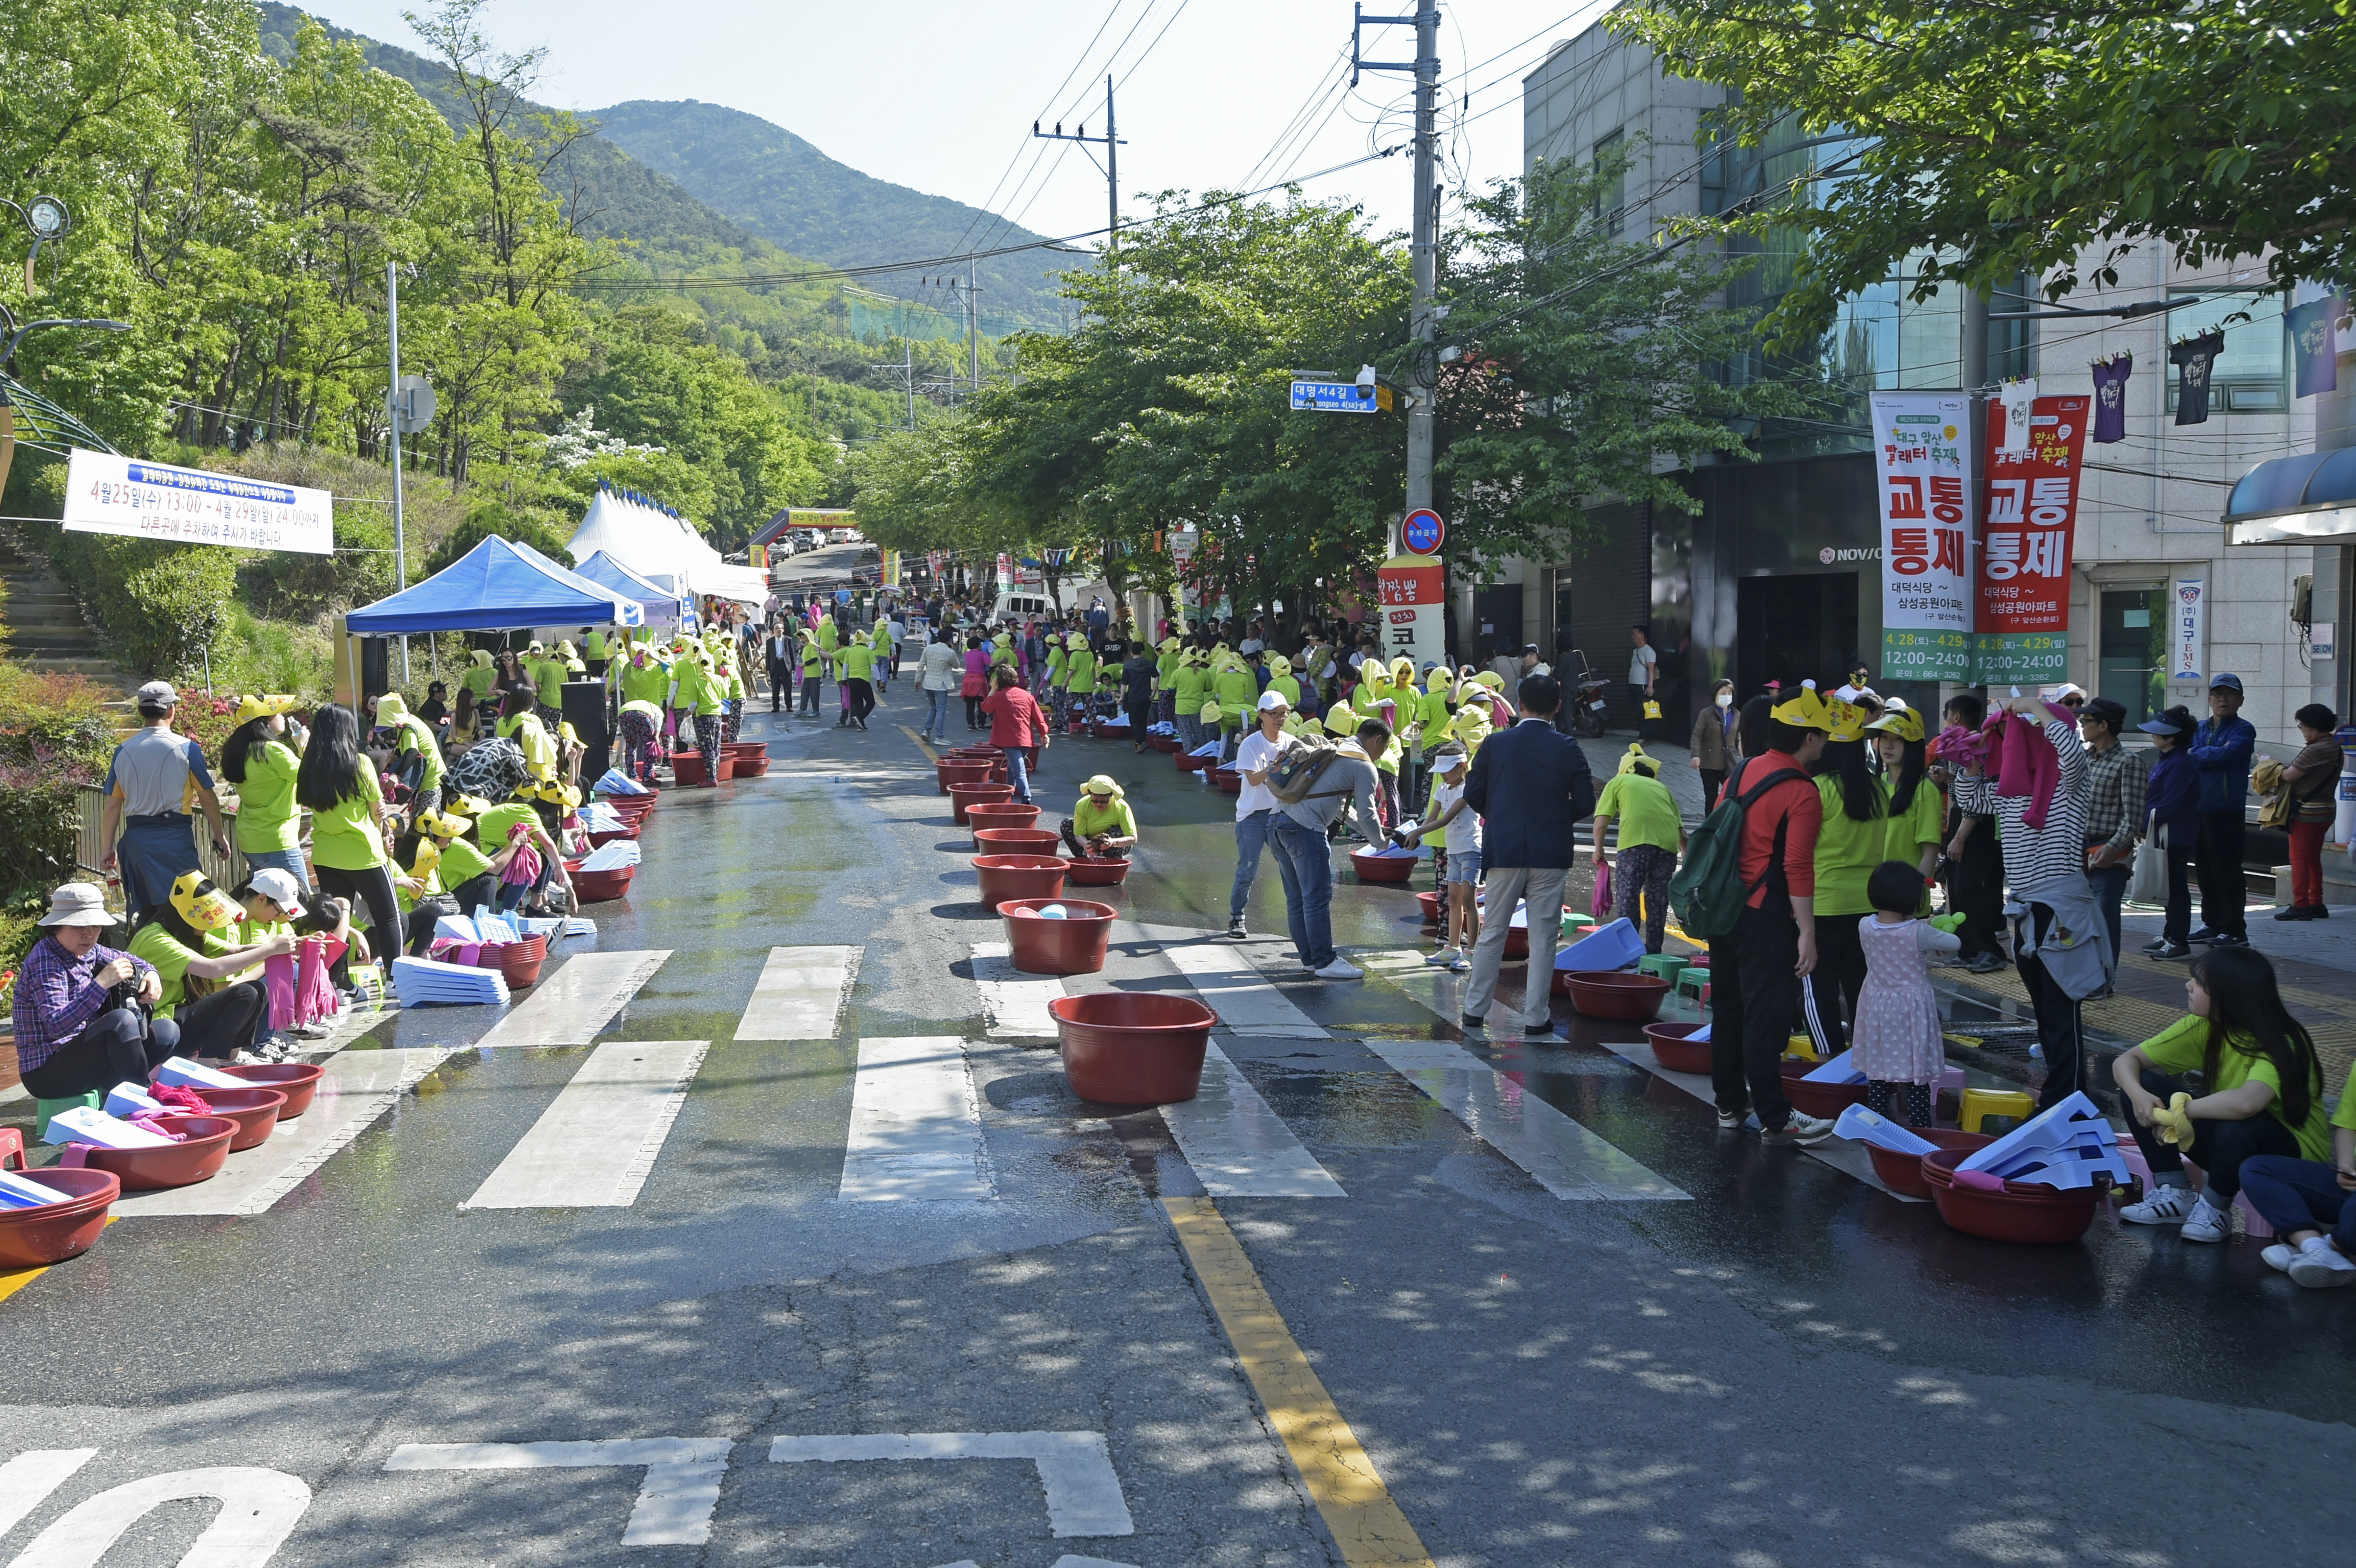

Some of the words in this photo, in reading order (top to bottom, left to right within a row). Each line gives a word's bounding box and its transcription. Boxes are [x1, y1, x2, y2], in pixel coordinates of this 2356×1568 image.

[1295, 385, 1346, 399] 대명서4길
[1897, 432, 1918, 445] 대구
[1921, 431, 1942, 446] 앞산
[2035, 432, 2056, 445] 앞산
[1885, 445, 1927, 465] 빨래터
[1931, 446, 1957, 464] 축제
[2040, 446, 2069, 463] 축제
[167, 491, 201, 513] 13:00
[1888, 476, 1964, 524] 교통
[1987, 477, 2071, 526] 교통
[183, 520, 218, 541] 주차하여
[222, 524, 246, 544] 주시기
[1408, 529, 1438, 537] 주차금지
[1891, 528, 1964, 577] 통제
[1986, 531, 2065, 580] 통제
[1892, 582, 1932, 594] 대덕식당
[1985, 587, 2019, 598] 대덕식당
[1898, 598, 1963, 611] 삼성공원아파트
[1989, 601, 2057, 614] 삼성공원아파트
[1391, 611, 1413, 622] 런치
[2022, 616, 2059, 624] 앞산순환로)
[1886, 651, 1969, 668] 12:00~24:00
[1977, 654, 2063, 669] 12:00~24:00
[1895, 669, 1912, 677] 문의
[1923, 670, 1961, 679] 664-3262
[2009, 674, 2050, 682] 664-3262
[205, 896, 218, 906] 대구
